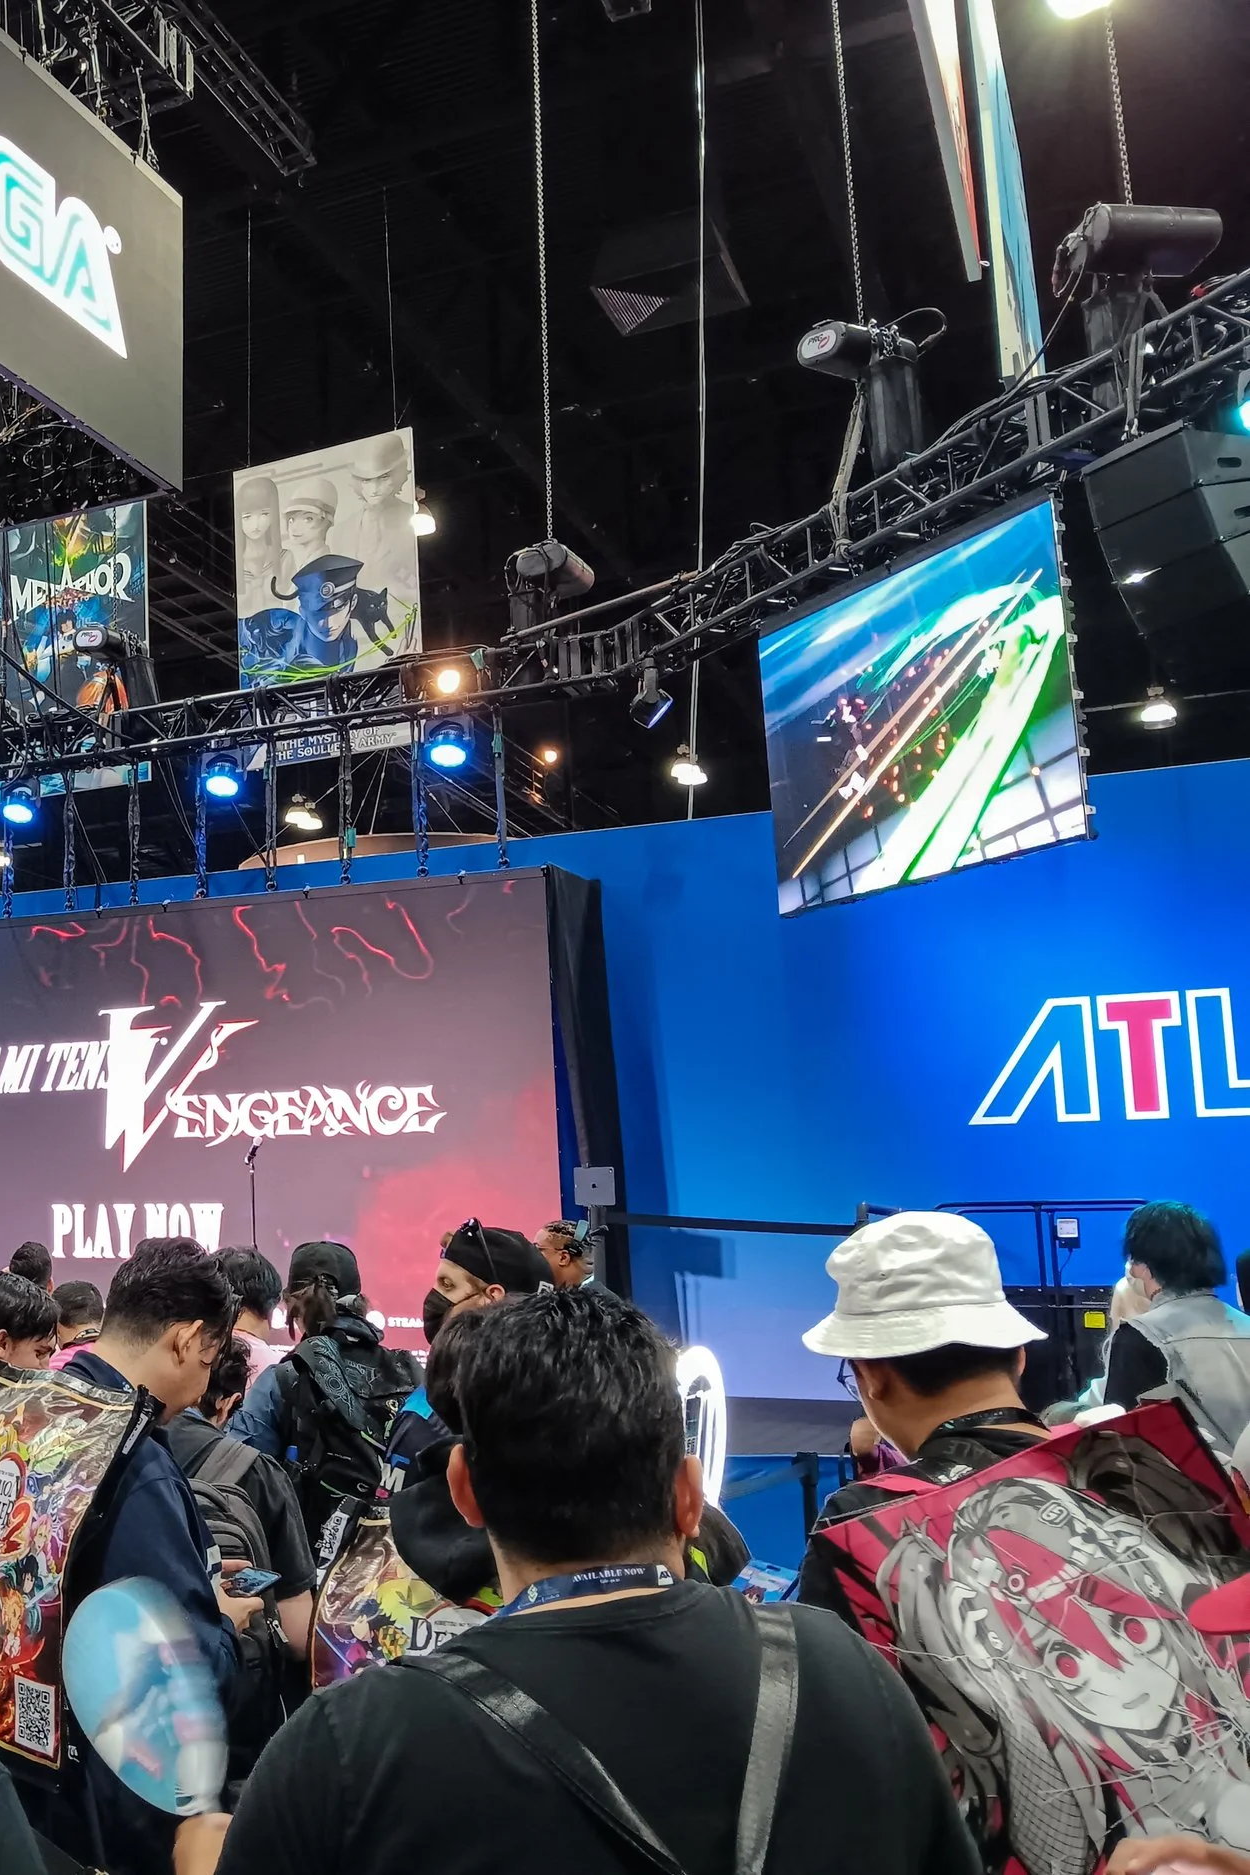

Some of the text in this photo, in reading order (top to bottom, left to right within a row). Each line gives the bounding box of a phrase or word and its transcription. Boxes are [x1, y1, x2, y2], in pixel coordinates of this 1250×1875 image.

[282, 737, 305, 750] THE
[363, 726, 381, 737] OF
[276, 749, 294, 761] HE
[967, 987, 1250, 1126] ATL
[50, 1203, 225, 1258] PLAY NOW
[572, 1567, 647, 1583] AVAILABLE NOW
